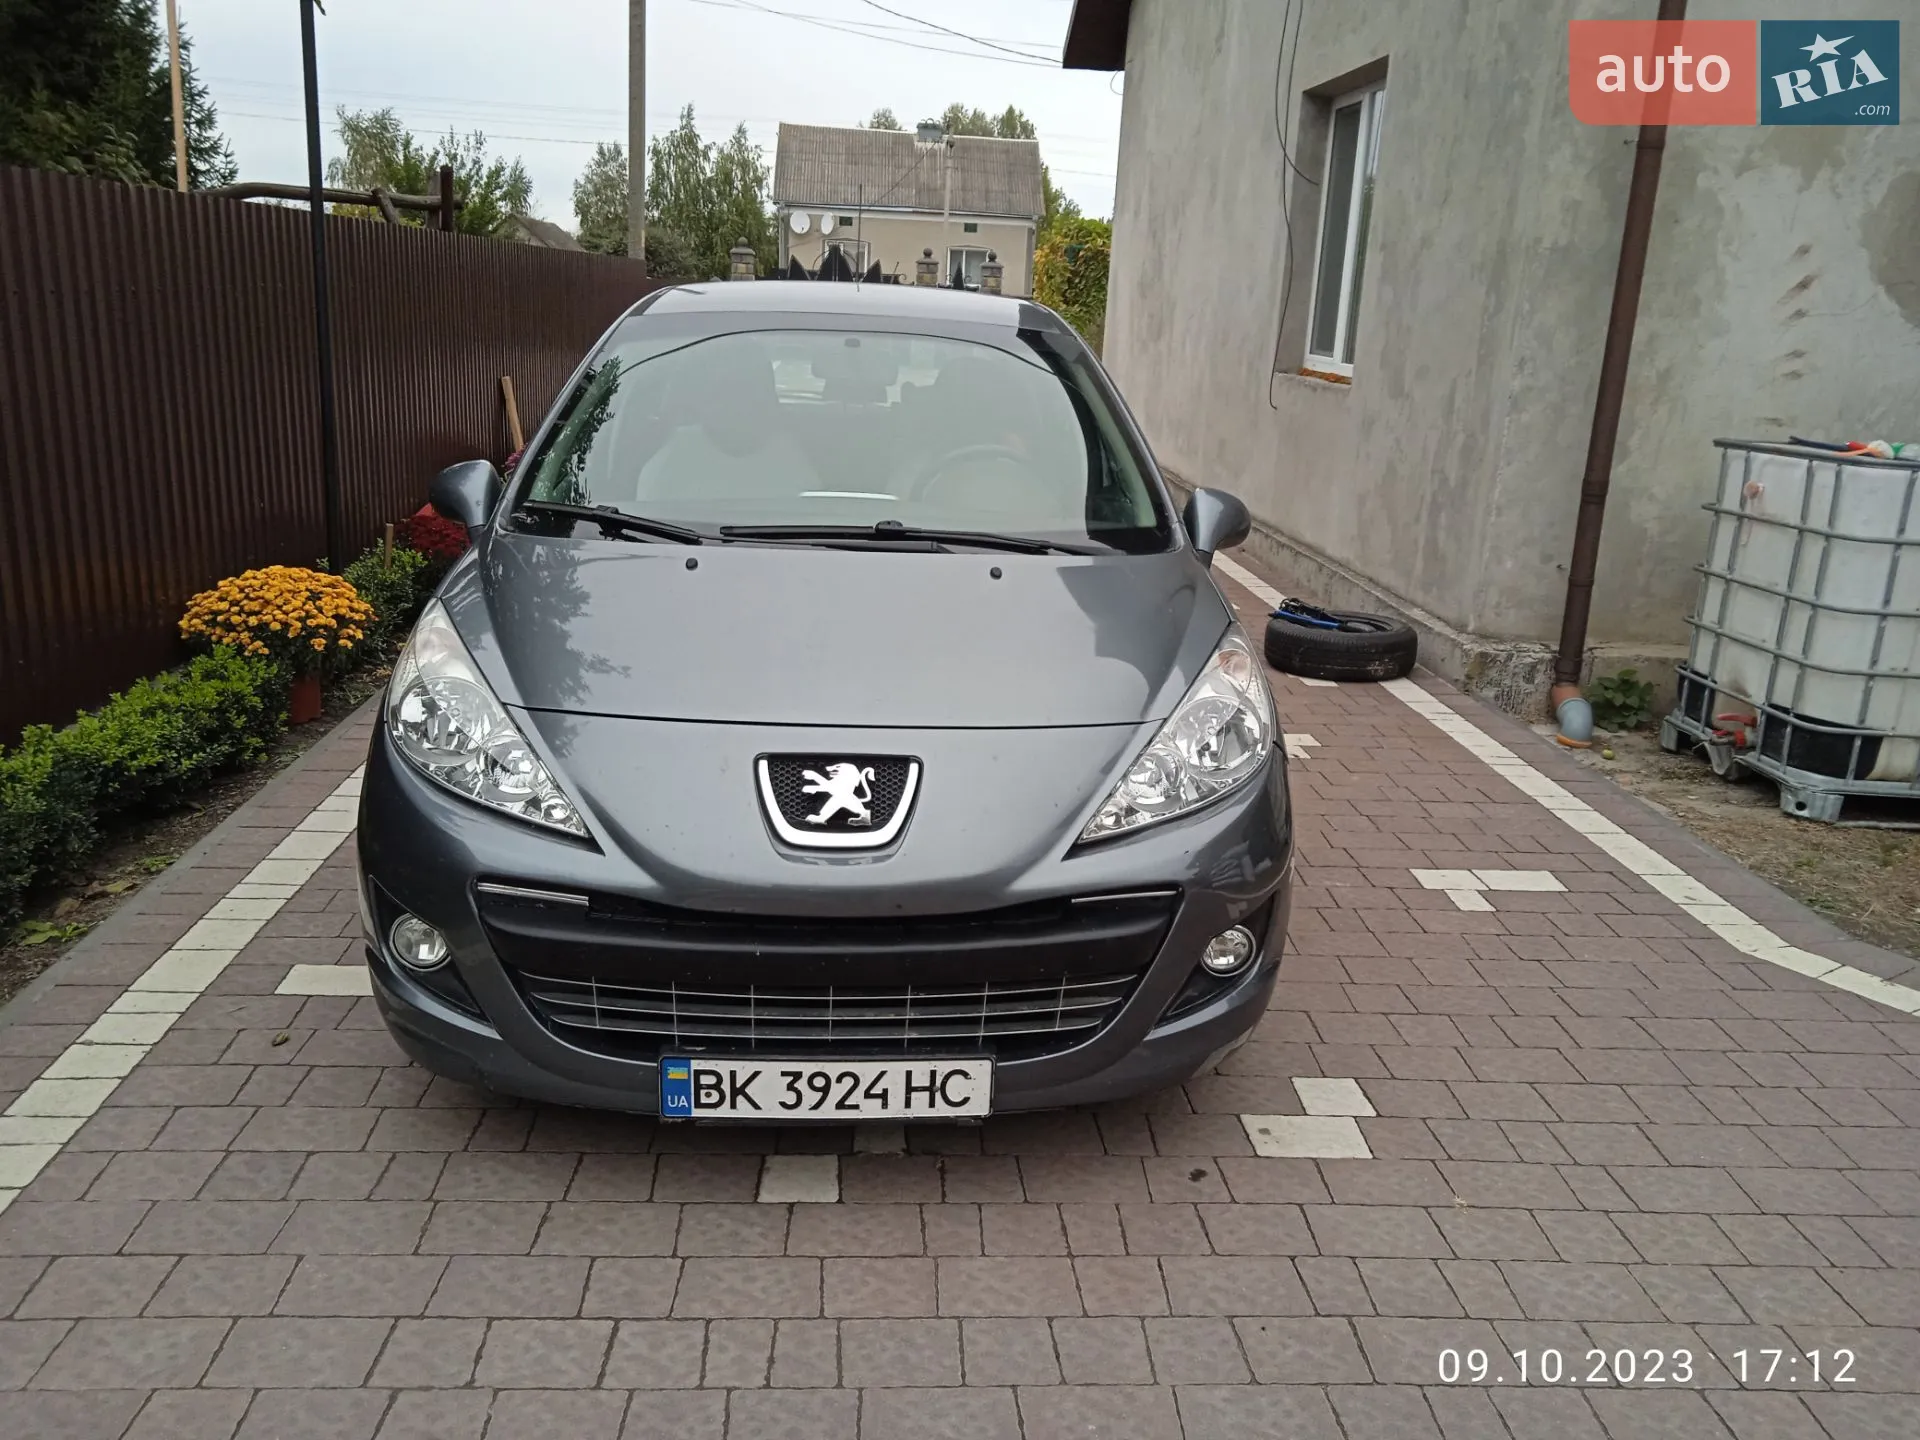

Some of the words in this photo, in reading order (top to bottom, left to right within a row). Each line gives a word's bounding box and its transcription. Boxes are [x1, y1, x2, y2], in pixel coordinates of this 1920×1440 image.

[667, 1095, 689, 1108] UA
[693, 1068, 763, 1111] BK
[778, 1070, 889, 1111] 3924
[904, 1068, 972, 1109] HC
